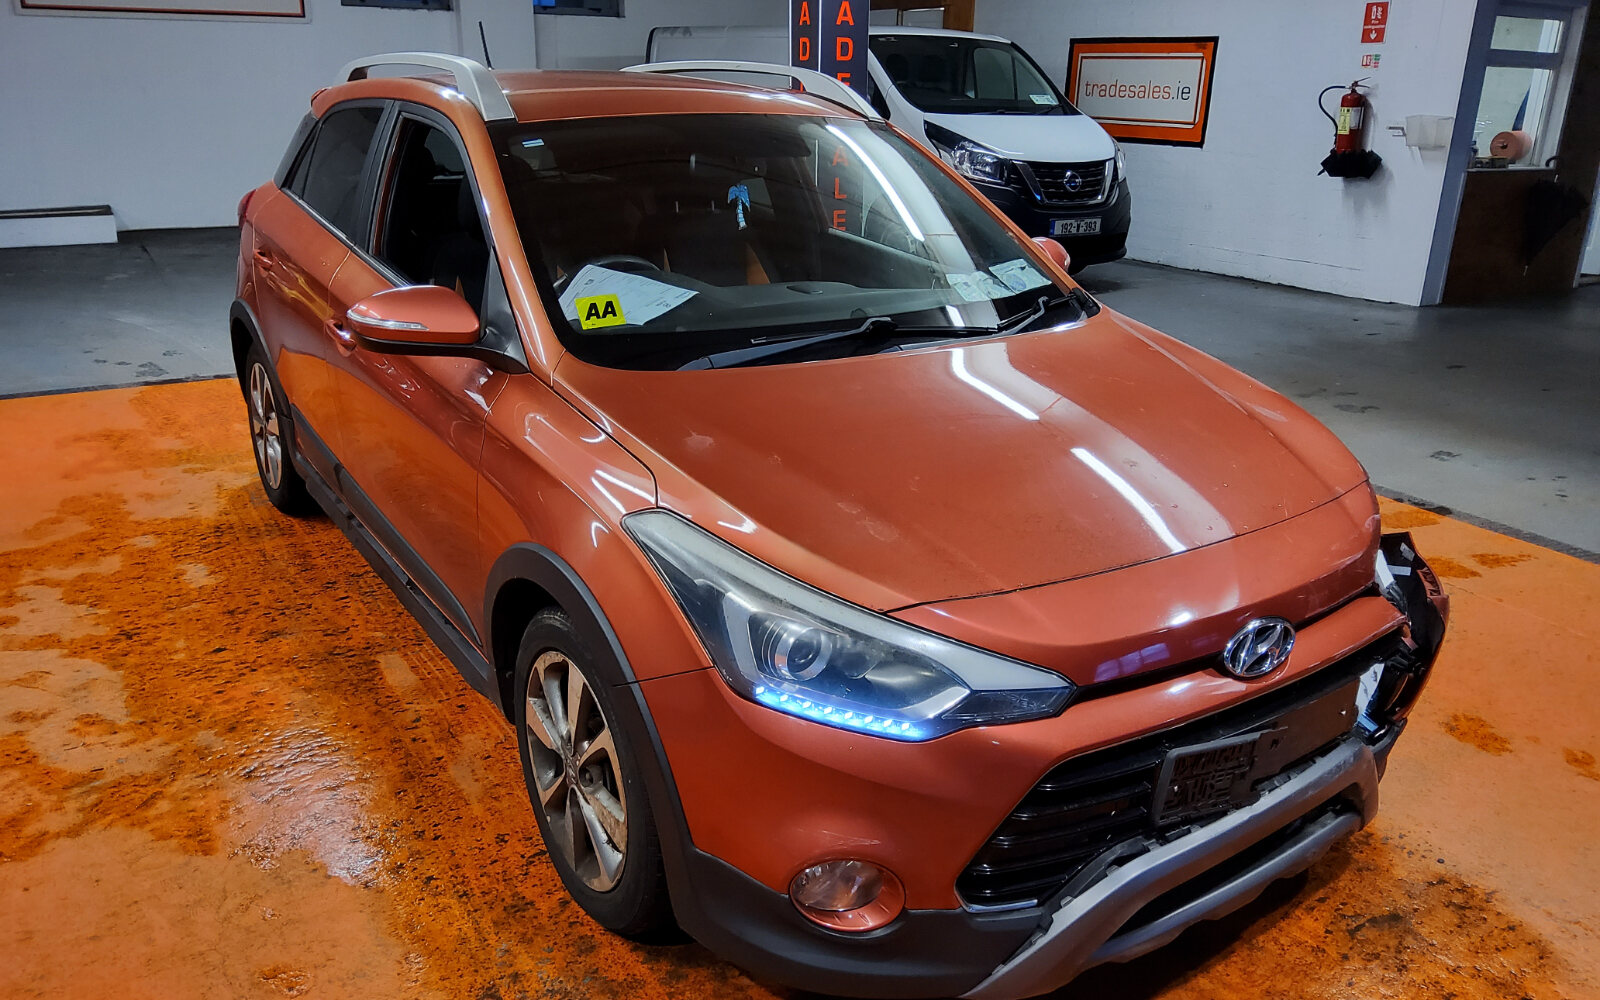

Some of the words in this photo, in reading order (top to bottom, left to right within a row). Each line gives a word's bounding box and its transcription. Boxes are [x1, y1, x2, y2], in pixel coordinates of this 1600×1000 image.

[799, 1, 811, 92] AD
[1085, 79, 1191, 101] tradesales.ie
[1060, 220, 1097, 234] 192-W-393
[585, 300, 618, 321] AA
